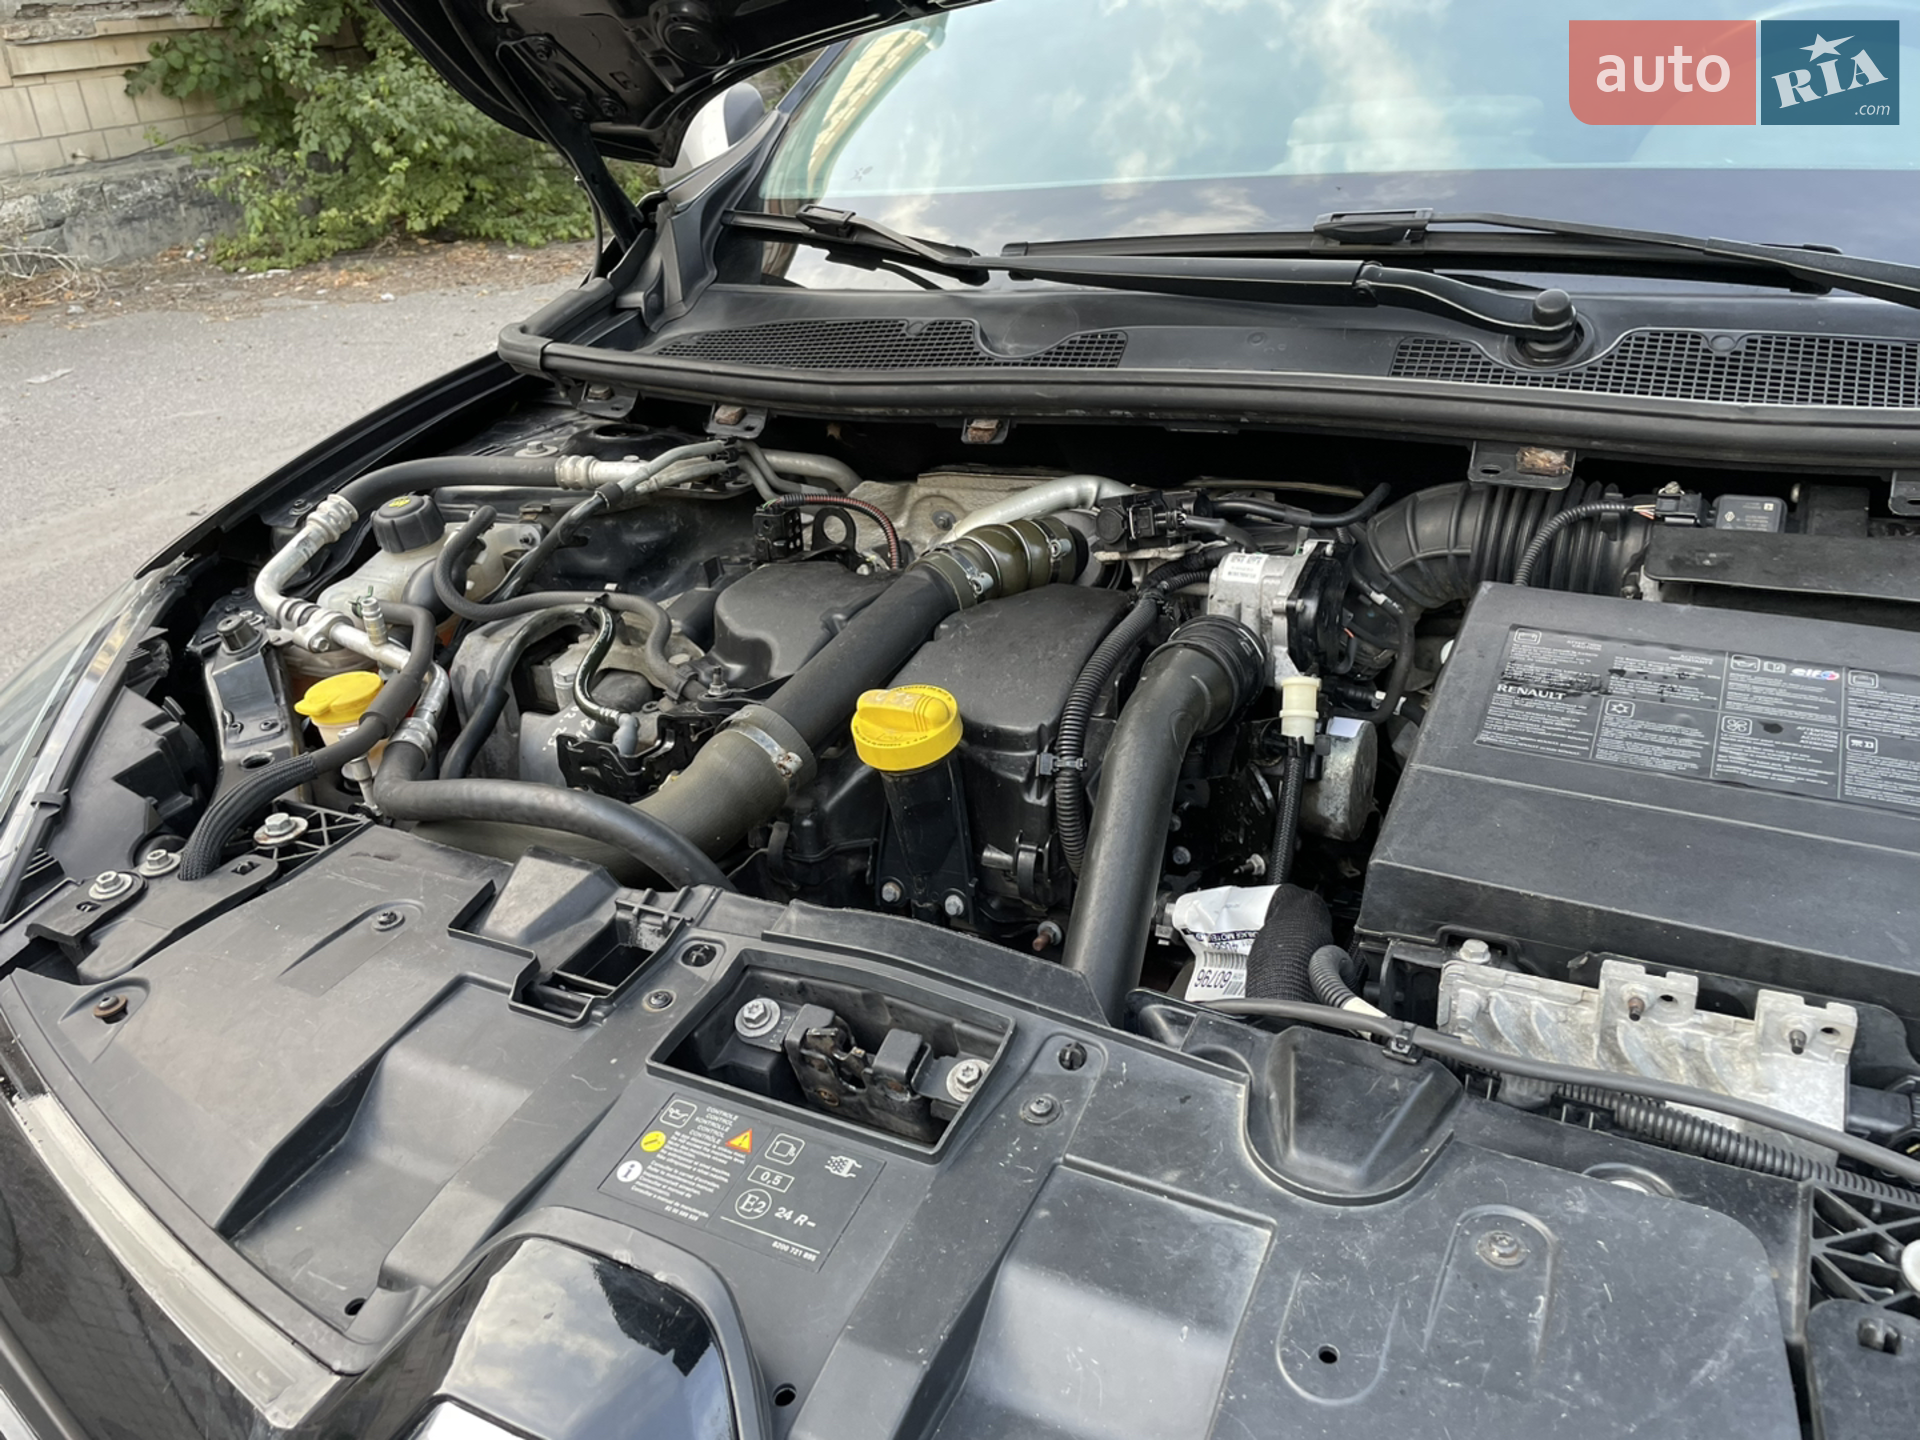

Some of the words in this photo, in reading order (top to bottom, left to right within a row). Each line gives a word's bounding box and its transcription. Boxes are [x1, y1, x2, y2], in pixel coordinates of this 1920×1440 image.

[1497, 684, 1566, 700] RENAULT
[1194, 969, 1232, 989] 60796
[760, 1171, 783, 1186] 0,5
[739, 1193, 767, 1213] E2
[774, 1207, 794, 1221] 24
